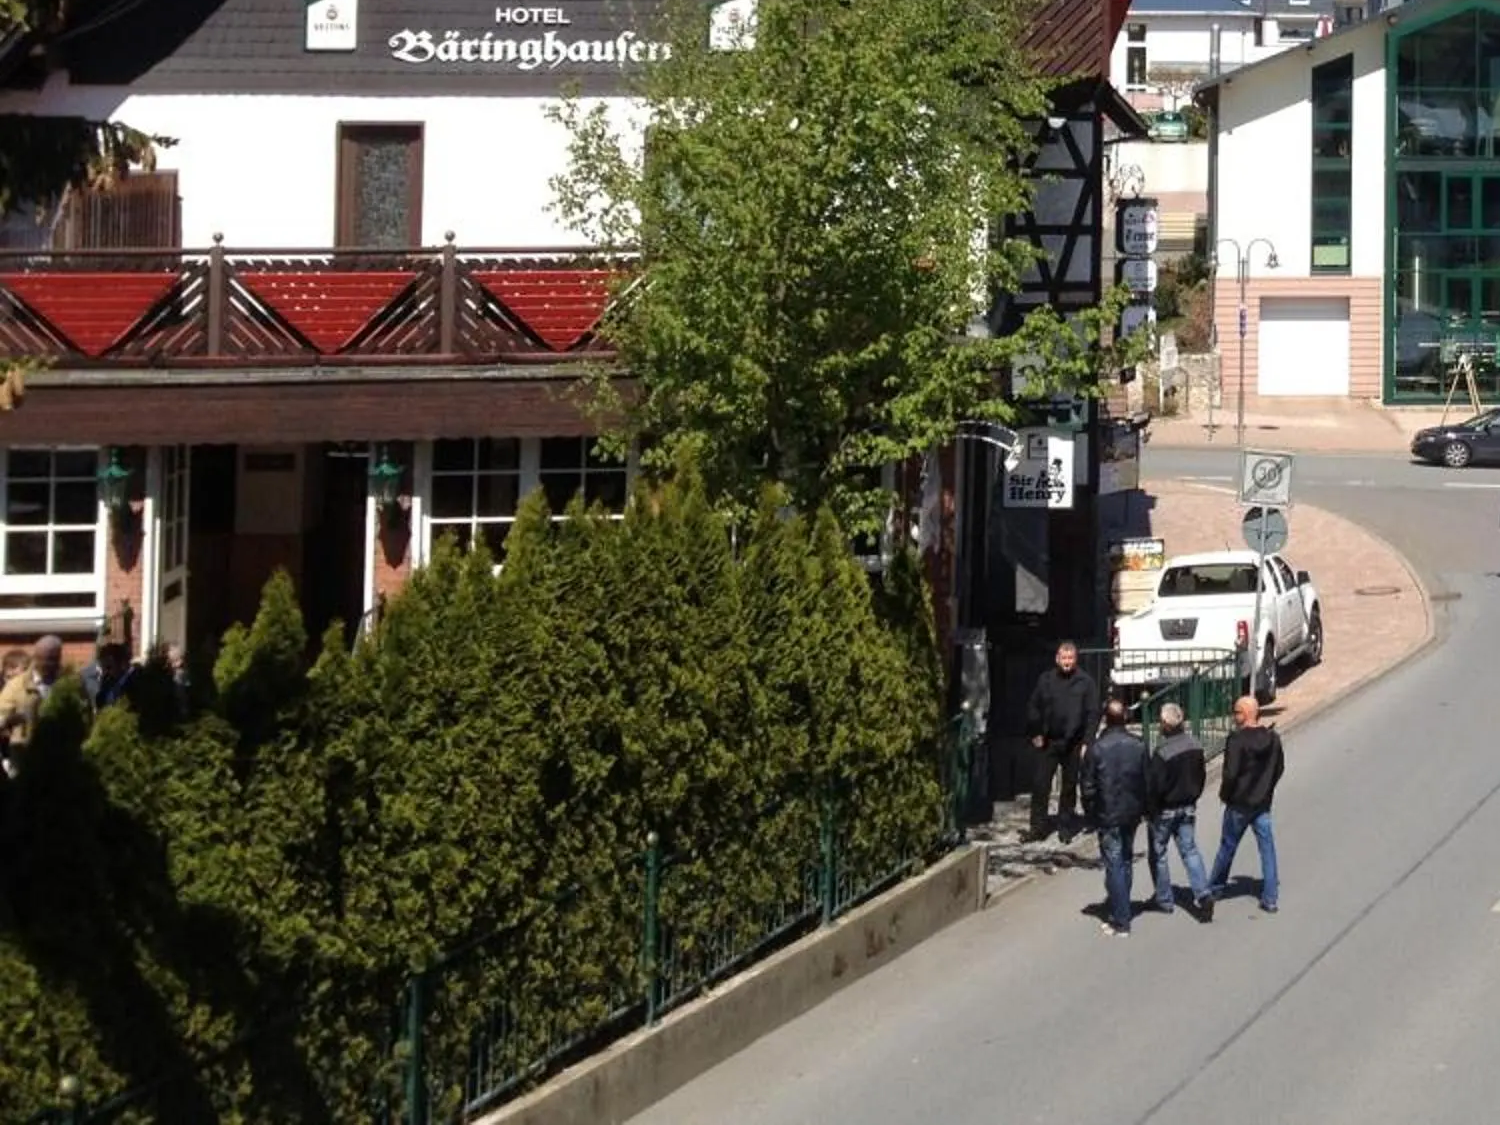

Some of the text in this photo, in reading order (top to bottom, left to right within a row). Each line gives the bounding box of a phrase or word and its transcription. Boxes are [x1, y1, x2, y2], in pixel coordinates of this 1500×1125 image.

[495, 7, 570, 24] HOTEL
[1008, 474, 1034, 486] Sir
[1258, 466, 1277, 482] 30
[1008, 486, 1066, 504] Henry
